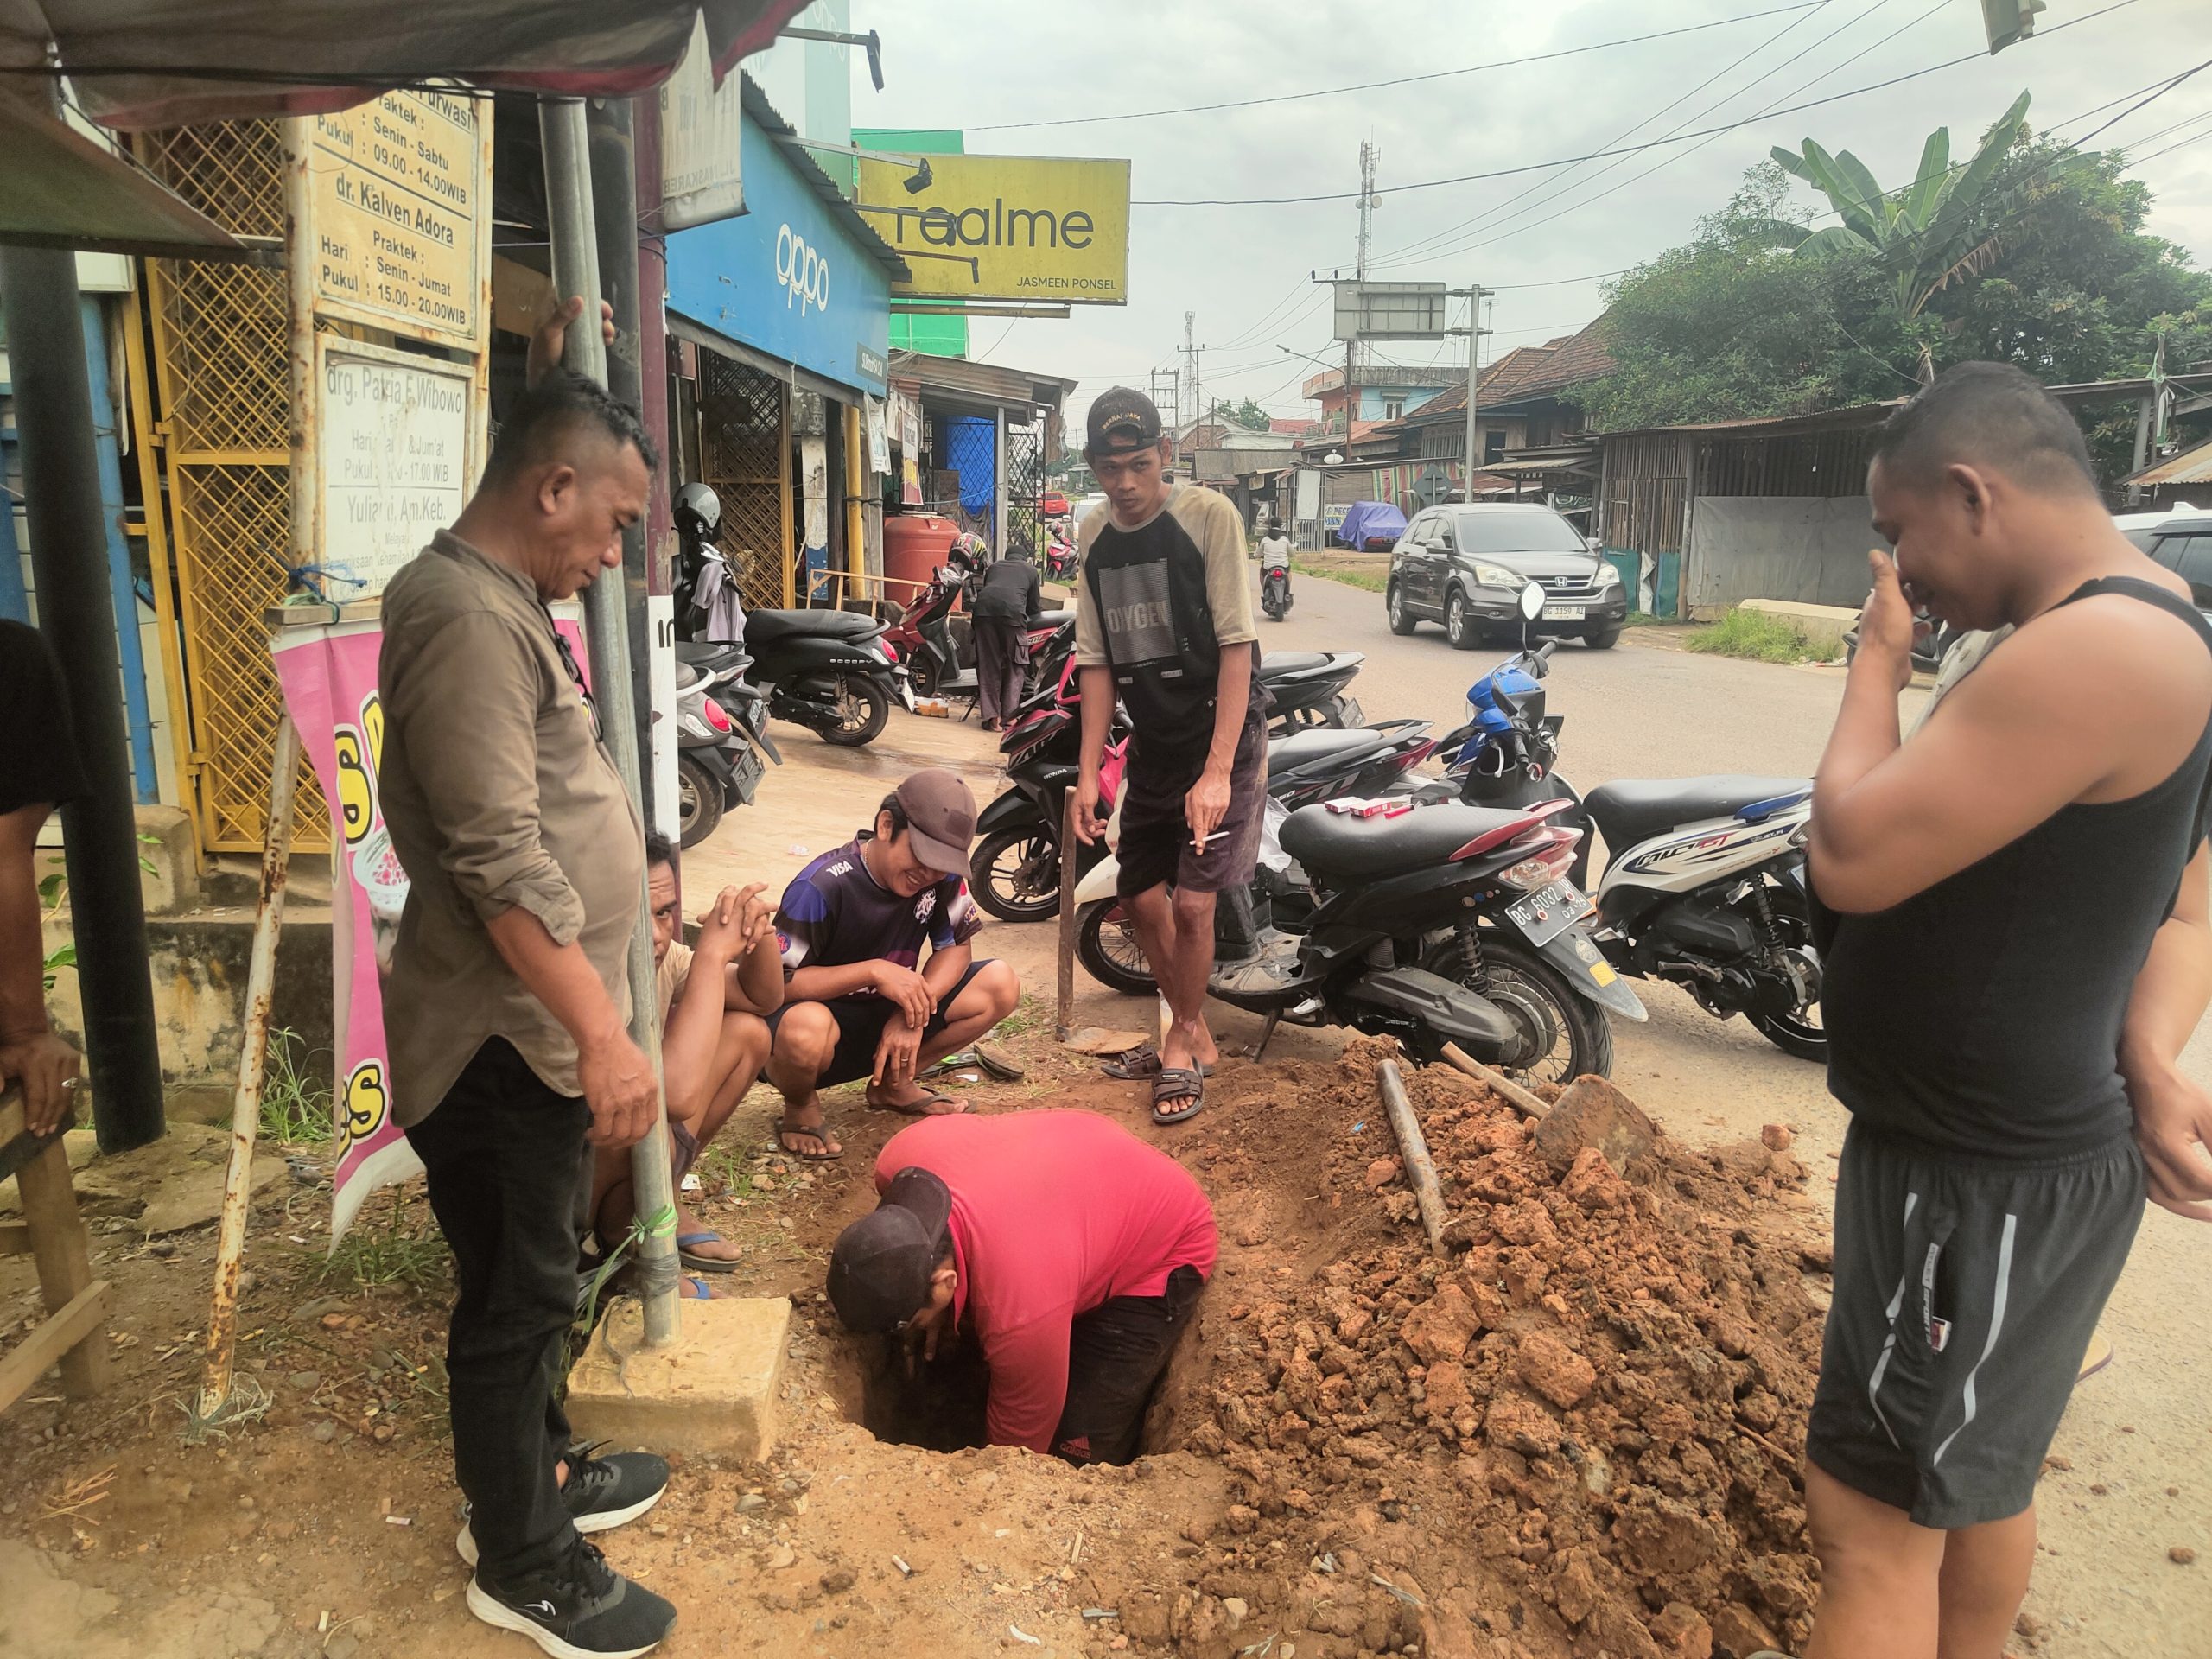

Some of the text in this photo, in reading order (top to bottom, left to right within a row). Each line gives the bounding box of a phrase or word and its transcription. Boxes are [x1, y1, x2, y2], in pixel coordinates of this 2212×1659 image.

[378, 96, 417, 127] raktek
[318, 114, 353, 148] Pukul
[374, 144, 406, 175] 09.00
[374, 116, 407, 148] Senin
[418, 141, 448, 171] Sabtu
[336, 173, 454, 245] dr. Kalven Adora
[896, 198, 1094, 249] realme
[373, 231, 417, 263] Praktek
[321, 235, 348, 261] Hari
[377, 257, 409, 283] Senin
[419, 272, 451, 297] Jumat
[322, 264, 359, 292] Pukul
[378, 283, 409, 307] 15.00
[1016, 276, 1116, 290] JASMEEN PONSEL
[327, 365, 358, 406] drg.
[352, 429, 372, 452] Hari
[346, 458, 372, 480] Pukul
[433, 463, 448, 482] WIB
[825, 861, 854, 878] VISA
[1531, 887, 1562, 917] 6032
[1059, 1442, 1091, 1459] adidas
